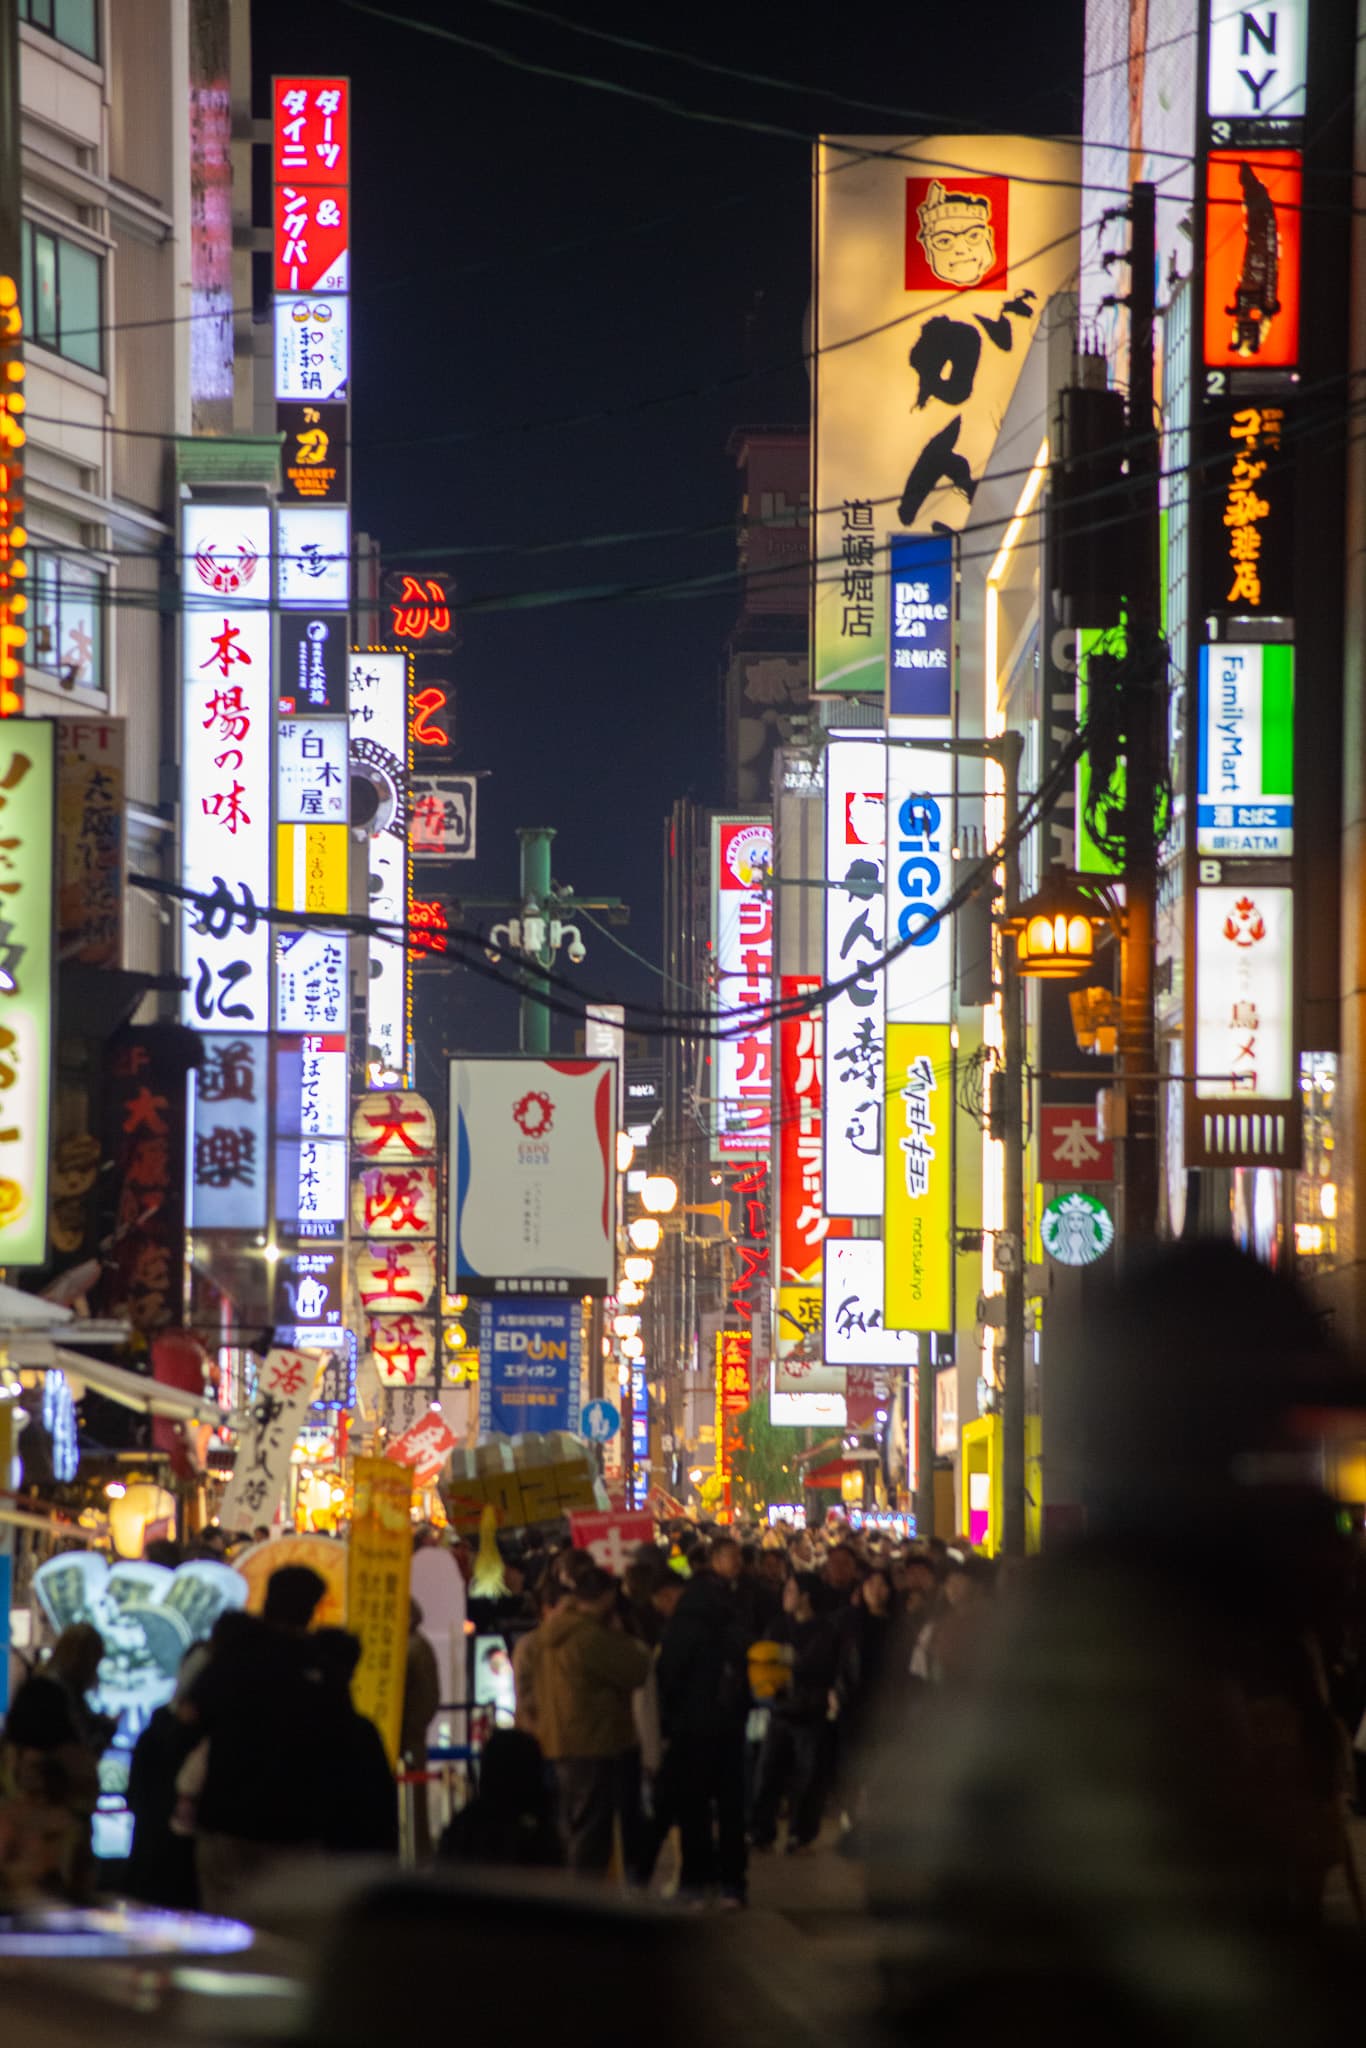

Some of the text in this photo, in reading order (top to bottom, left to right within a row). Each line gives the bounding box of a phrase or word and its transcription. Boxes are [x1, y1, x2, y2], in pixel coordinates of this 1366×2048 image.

[1238, 11, 1277, 110] NY
[315, 90, 341, 168] ダーツ
[1211, 121, 1231, 144] 3
[281, 90, 308, 290] ダイニングバー
[316, 200, 340, 226] &
[326, 276, 345, 289] 9F
[1207, 371, 1225, 395] 2
[841, 500, 875, 638] 道頓堀店
[1206, 616, 1218, 640] 1
[199, 617, 252, 835] 本場の味
[279, 725, 296, 739] 4F
[1216, 655, 1244, 793] FamilyMart
[299, 729, 342, 816] 白木屋
[729, 829, 767, 862] KARAOKE
[1212, 836, 1279, 849] 銀行ATM
[898, 796, 941, 947] GiGO
[1199, 861, 1222, 883] B
[902, 1058, 935, 1196] マツモトキヨシ
[1052, 1119, 1101, 1169] 本
[349, 1094, 431, 1386] 大阪王将
[912, 1216, 923, 1301] matsukiyo
[494, 1331, 567, 1360] EDION
[503, 1364, 557, 1377] エディオン
